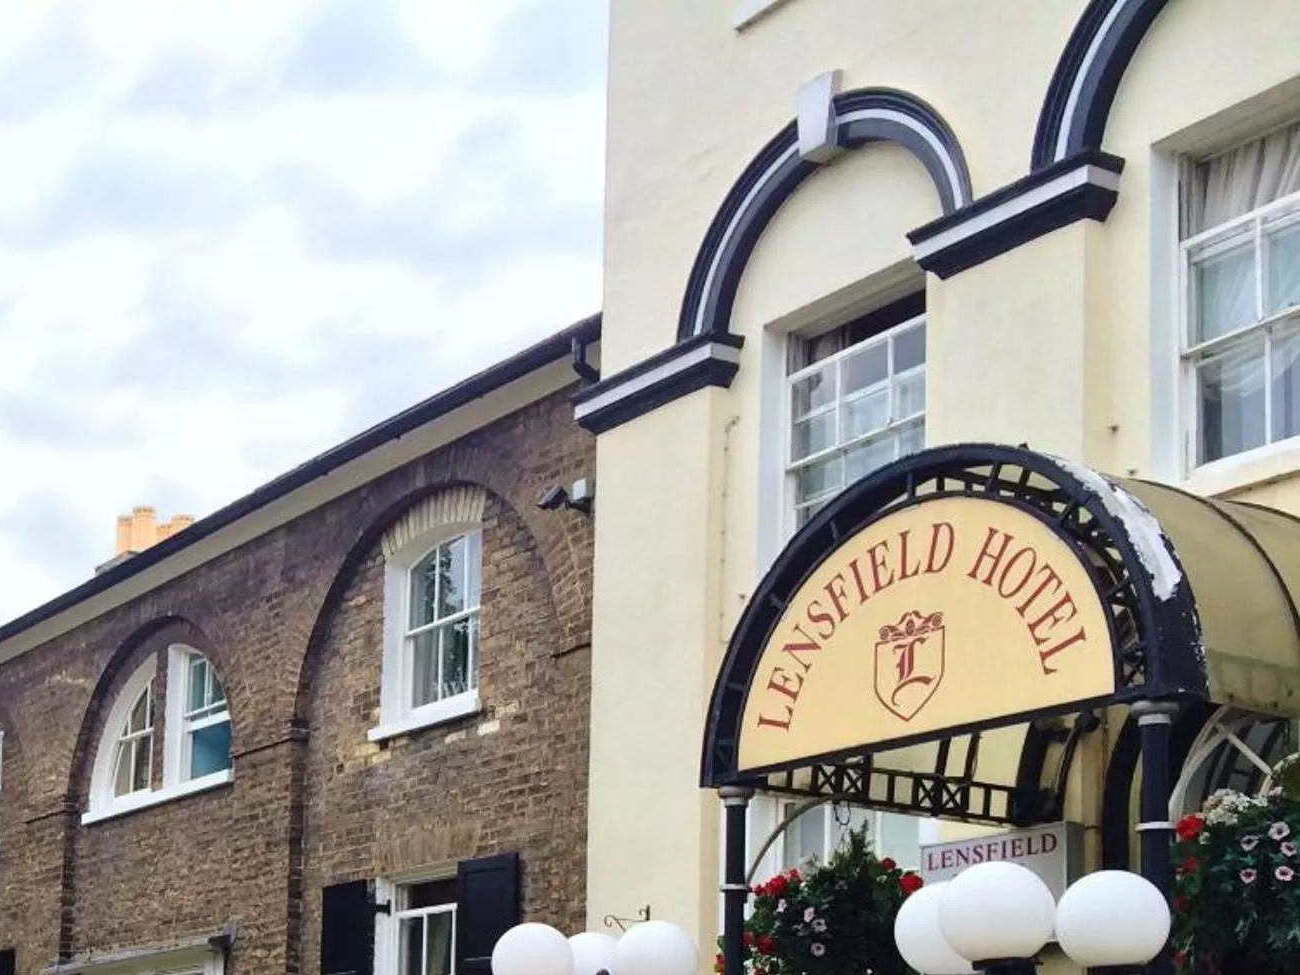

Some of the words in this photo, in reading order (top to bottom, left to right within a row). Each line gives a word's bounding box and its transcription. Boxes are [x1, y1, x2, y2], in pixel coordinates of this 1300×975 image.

[758, 522, 955, 732] LENSFIELD
[967, 526, 1087, 676] HOTEL
[927, 833, 1058, 871] LENSFIELD
